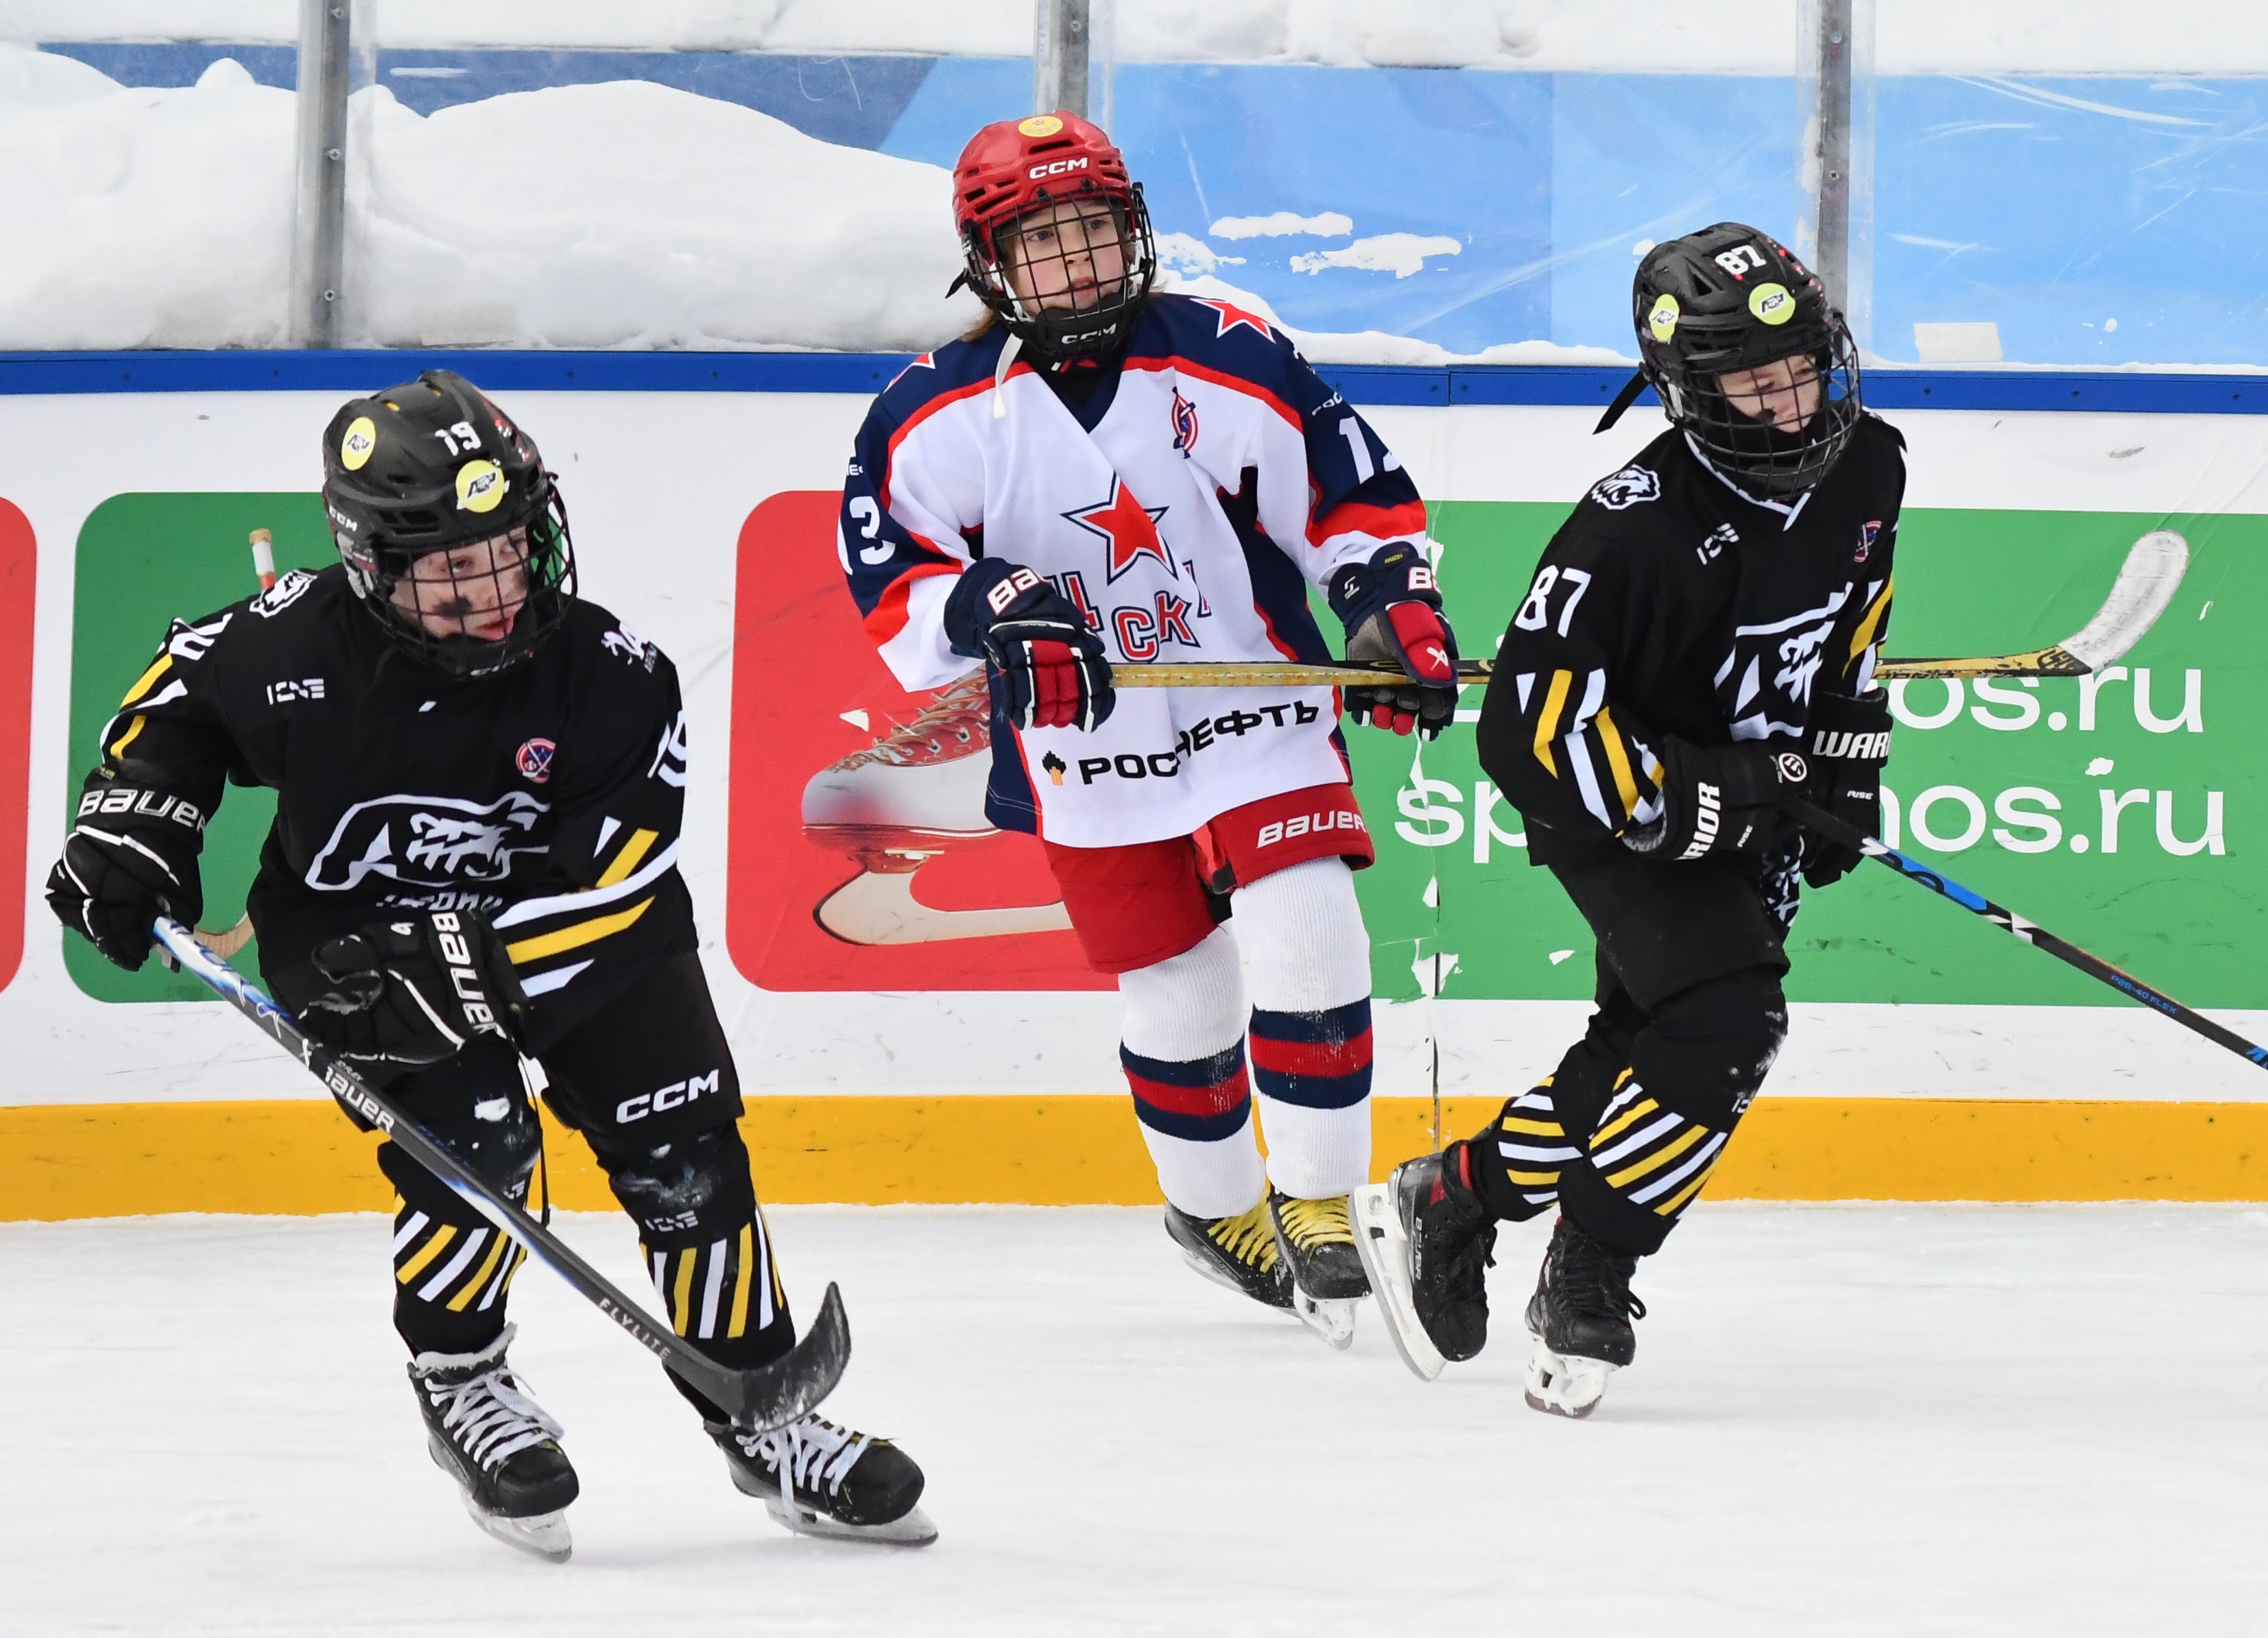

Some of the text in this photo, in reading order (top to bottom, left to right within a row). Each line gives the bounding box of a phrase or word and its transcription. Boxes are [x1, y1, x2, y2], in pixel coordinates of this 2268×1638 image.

[1029, 157, 1088, 180] CCM
[1715, 244, 1767, 276] 87
[1061, 323, 1117, 344] CCM
[435, 421, 482, 457] 19
[1514, 564, 1592, 639] 87
[1077, 699, 1320, 785] РОСНЕФТЬ
[1673, 782, 1721, 860] RIOR
[616, 1068, 719, 1124] CCM
[599, 1297, 672, 1360] FLYLITE
